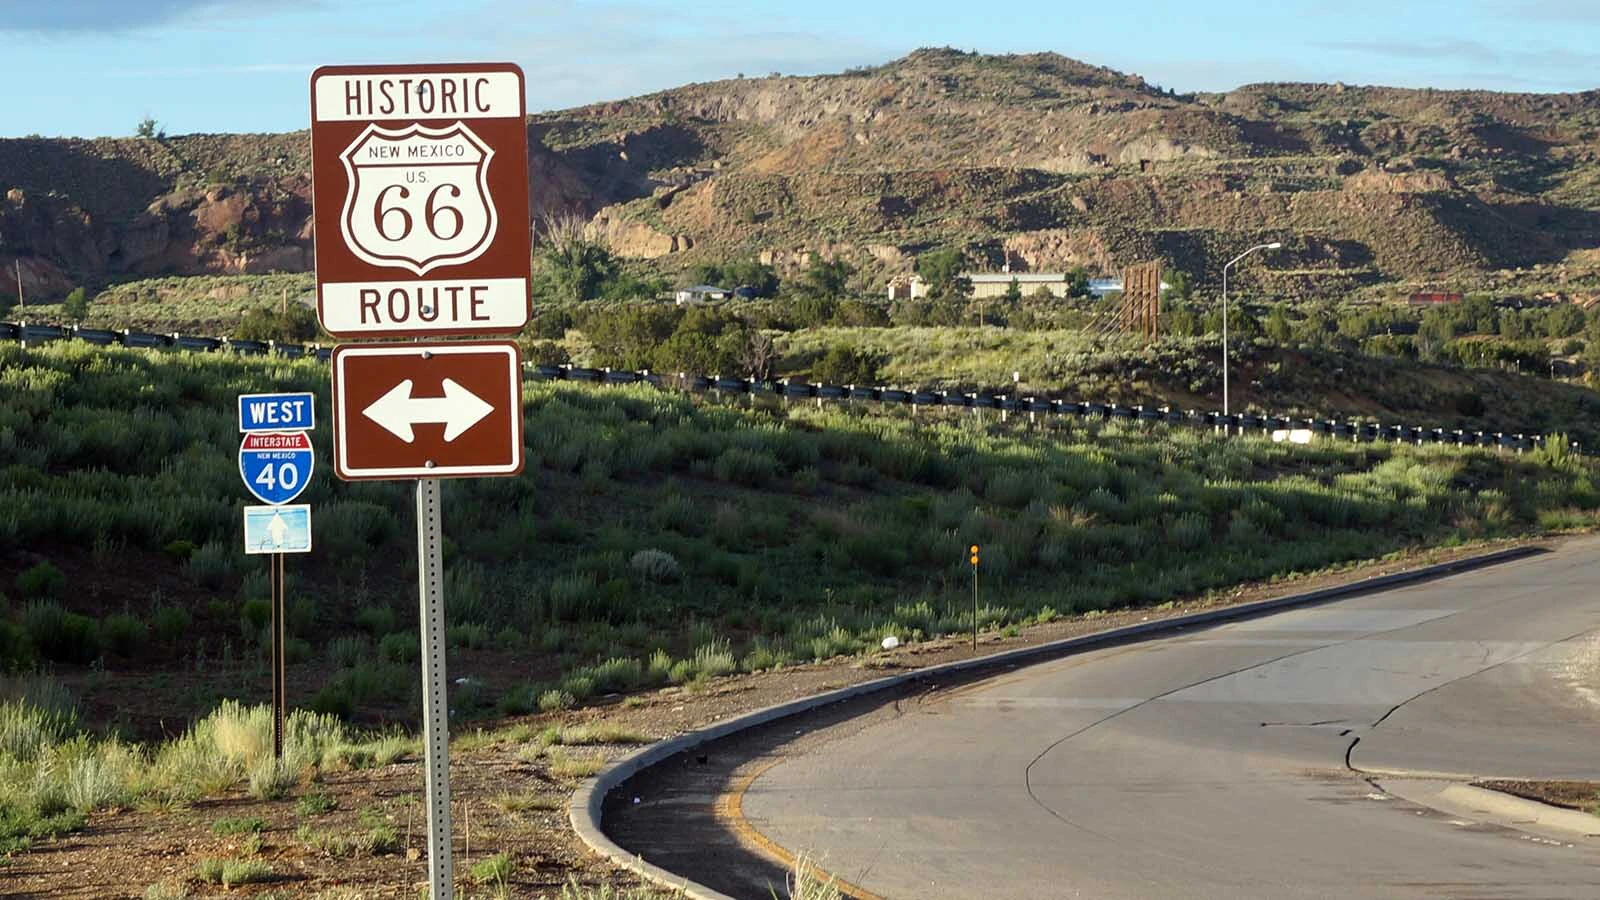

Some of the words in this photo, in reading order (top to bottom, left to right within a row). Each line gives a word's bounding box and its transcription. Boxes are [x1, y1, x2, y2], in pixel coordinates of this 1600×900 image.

[345, 78, 491, 115] HISTORIC
[369, 146, 400, 159] NEW
[408, 144, 465, 157] MEXICO
[406, 171, 430, 184] U.S.
[374, 183, 464, 242] 66
[360, 286, 490, 324] ROUTE
[250, 401, 304, 424] WEST
[250, 437, 301, 447] INTERSTATE
[255, 463, 298, 490] 40
